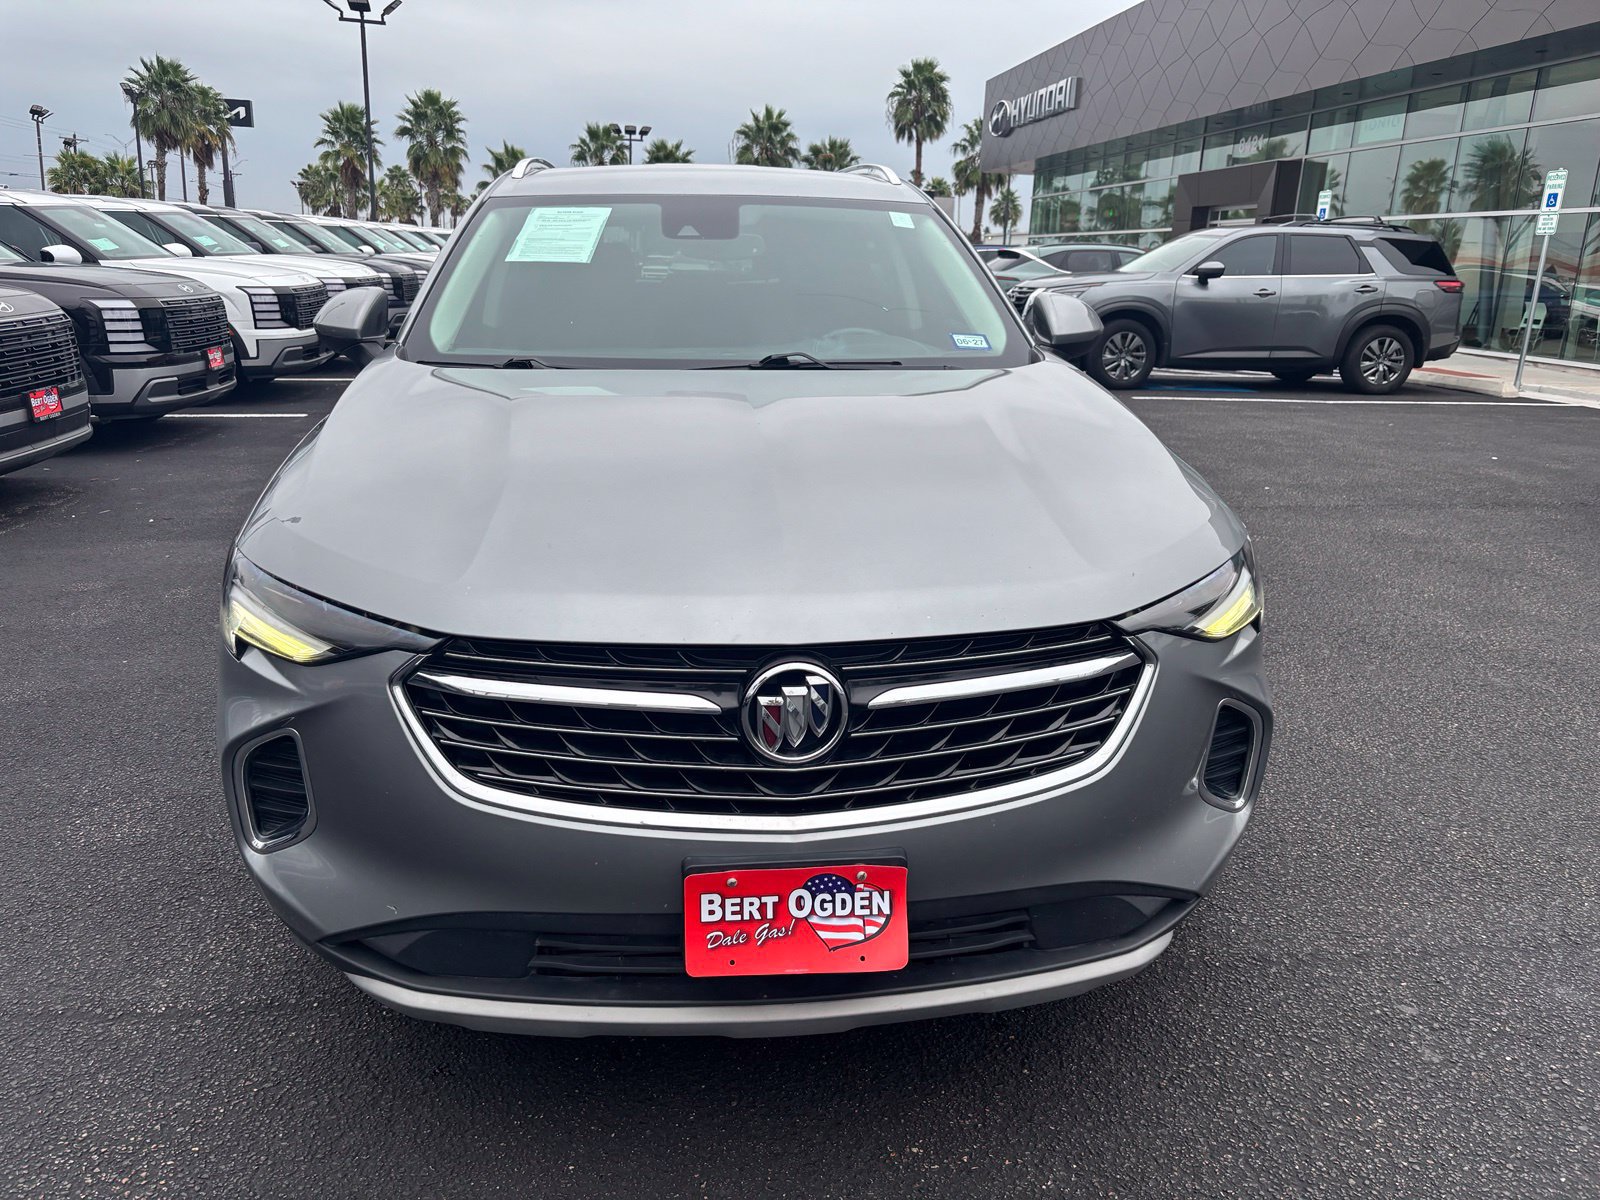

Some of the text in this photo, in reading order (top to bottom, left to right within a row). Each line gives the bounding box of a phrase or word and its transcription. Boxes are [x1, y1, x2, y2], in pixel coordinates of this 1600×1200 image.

[1010, 77, 1078, 128] HYUNDAI
[31, 398, 43, 406] BERT
[700, 887, 892, 923] BERT OGDEN
[706, 919, 796, 949] Dale Gas!
